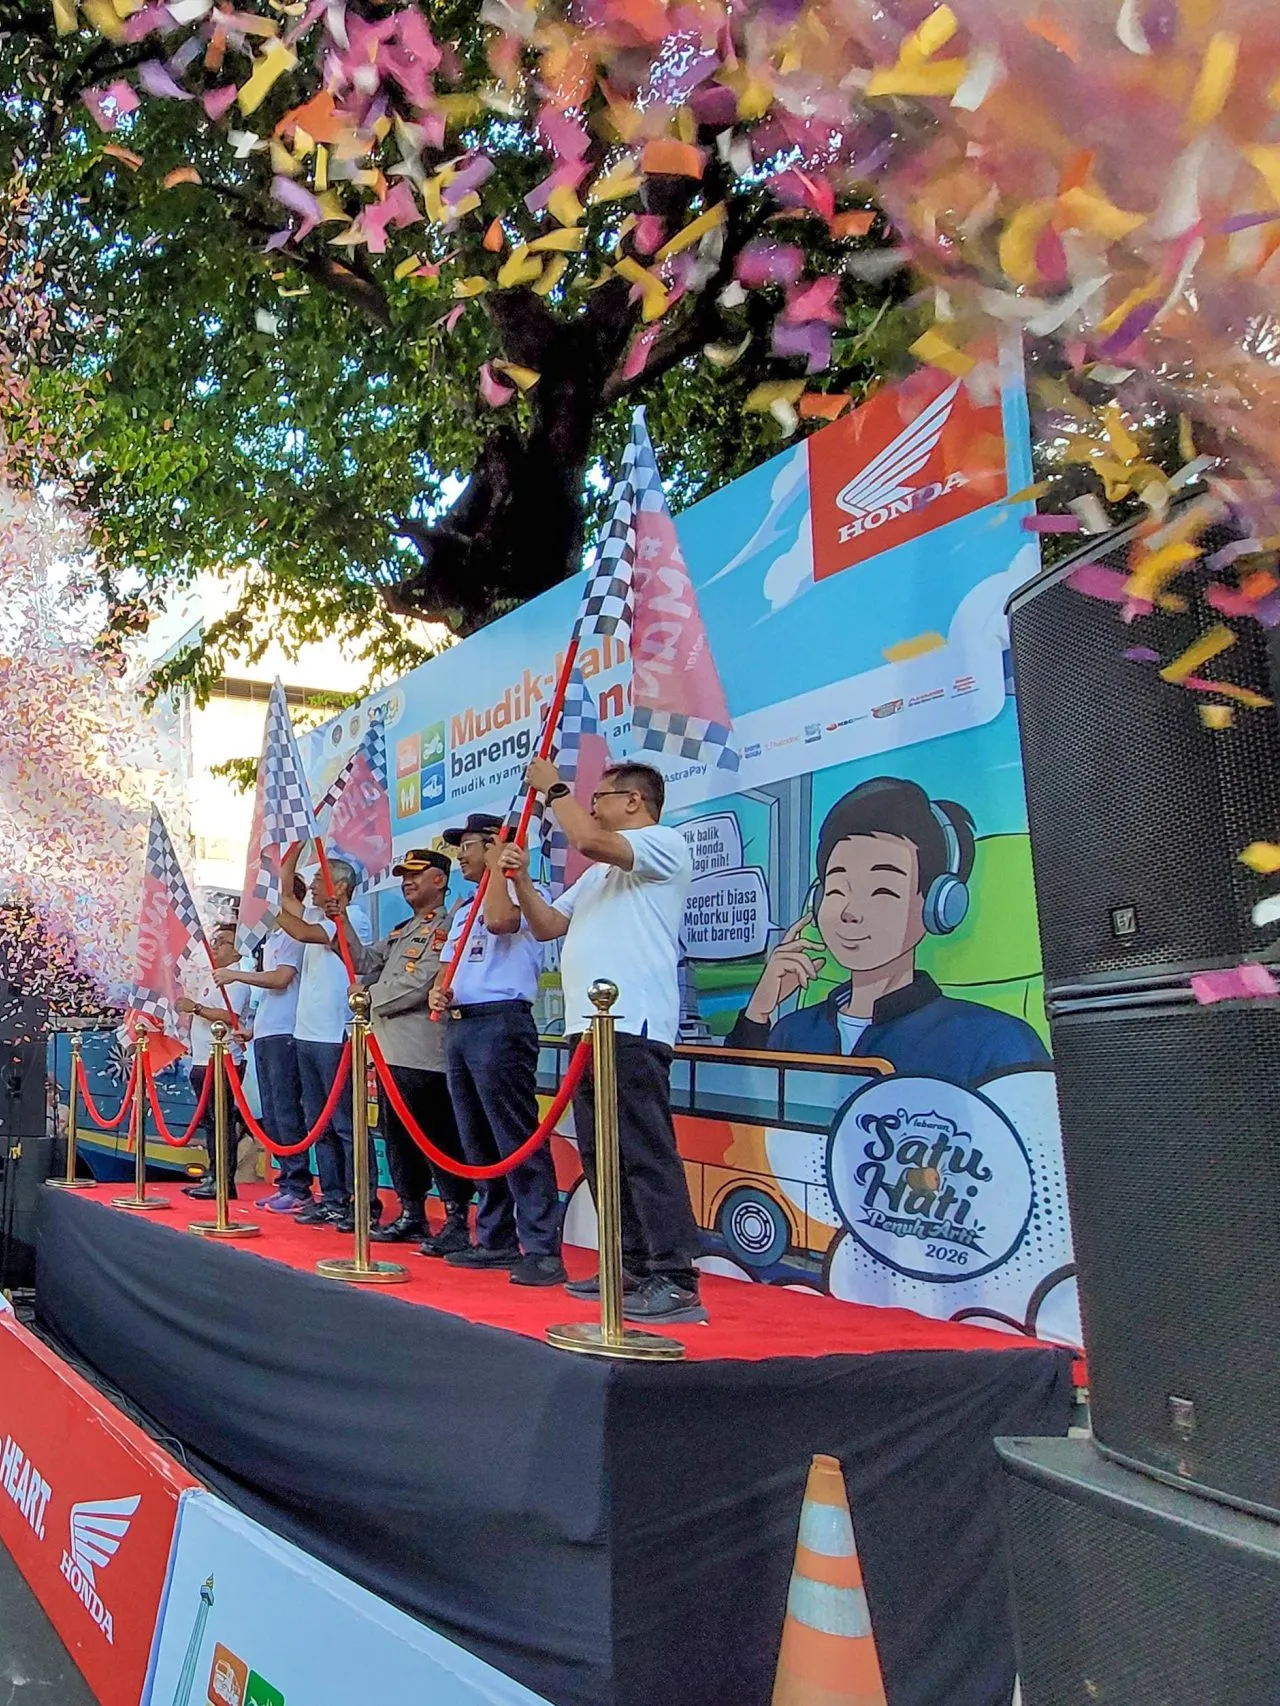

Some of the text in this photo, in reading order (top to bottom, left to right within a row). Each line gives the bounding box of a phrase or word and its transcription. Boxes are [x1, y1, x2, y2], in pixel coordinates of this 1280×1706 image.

[838, 471, 970, 544] HONDA
[450, 728, 531, 779] bareng
[451, 775, 486, 799] mudik
[697, 826, 720, 842] balik
[696, 840, 724, 857] Honda
[692, 853, 729, 873] lagi nih!
[686, 889, 757, 911] seperti biasa
[684, 907, 757, 926] Motorku juga
[687, 923, 755, 943] ikut bareng!
[858, 1114, 992, 1182] Satu
[857, 1161, 978, 1224] Hati
[868, 1207, 979, 1246] Penuh Arti
[925, 1243, 970, 1266] 2026
[0, 1434, 53, 1542] HEART.
[60, 1548, 114, 1646] HONDA
